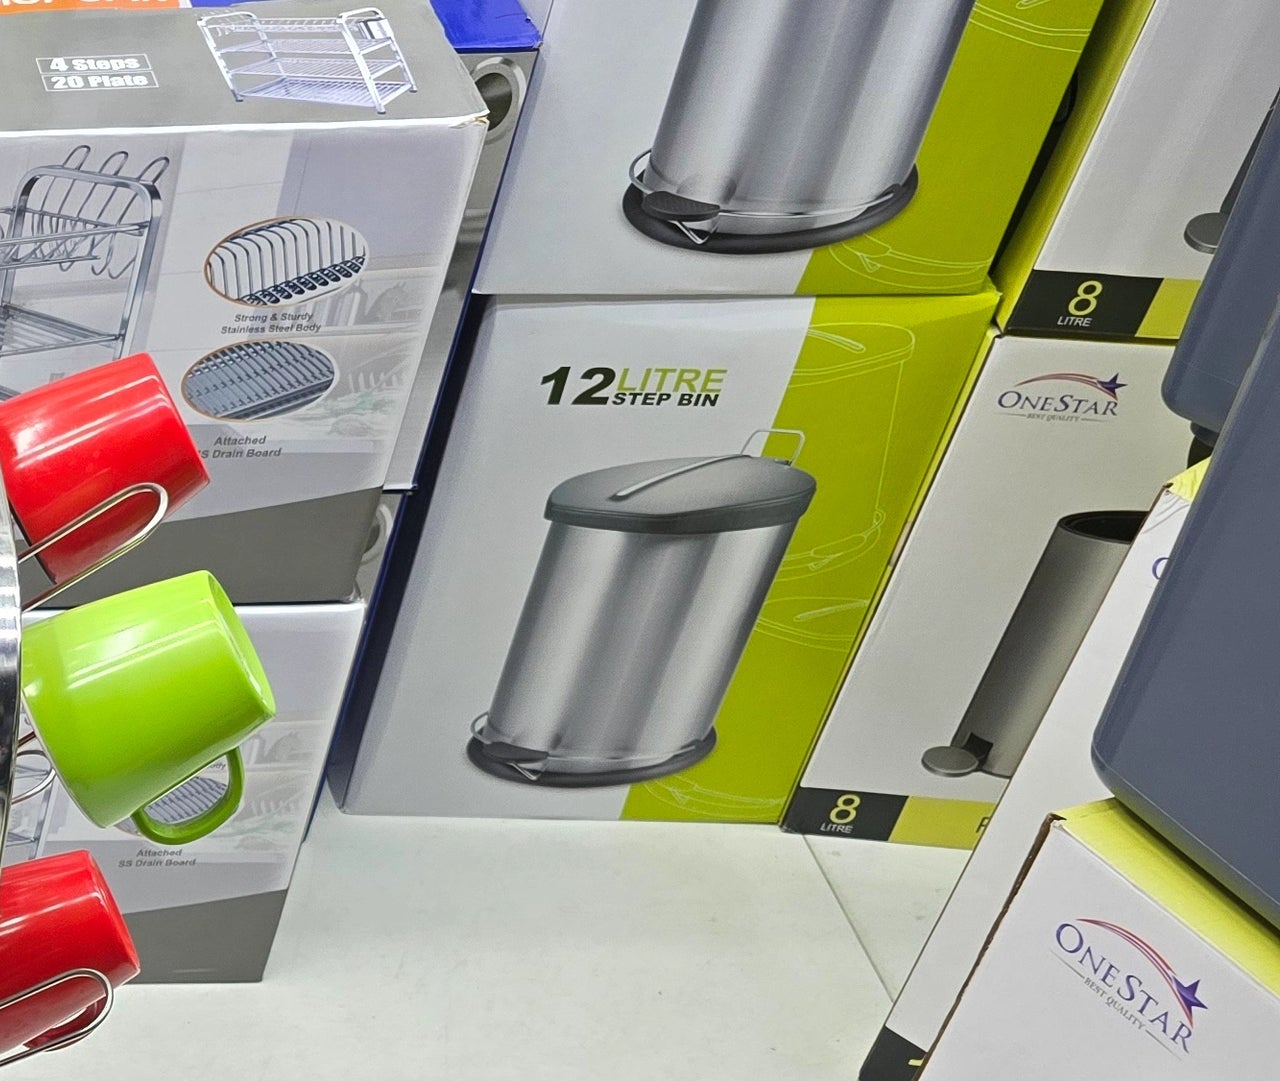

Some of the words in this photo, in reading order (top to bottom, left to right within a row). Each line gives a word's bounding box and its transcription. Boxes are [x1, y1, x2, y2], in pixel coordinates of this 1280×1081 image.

[49, 57, 69, 71] 4
[72, 57, 140, 71] Steps
[50, 75, 84, 89] 20
[87, 74, 148, 87] Plate
[1068, 280, 1103, 316] 8
[234, 313, 267, 323] Strong
[270, 313, 278, 321] &
[280, 312, 313, 323] Sturdy
[1057, 316, 1092, 327] LITRE
[220, 326, 266, 334] Stainless
[268, 325, 293, 333] Steel
[295, 324, 322, 333] Body
[540, 366, 616, 405] 12
[617, 368, 728, 393] LITRE
[612, 393, 671, 406] STEP
[677, 393, 720, 407] BIN
[214, 435, 266, 446] Attached
[212, 449, 243, 458] Drain
[246, 447, 282, 457] Board
[829, 793, 861, 824] 8
[820, 823, 854, 834] LITRE
[136, 849, 183, 857] Attached
[135, 859, 161, 867] Drain
[1084, 976, 1108, 998] BEST
[1104, 995, 1147, 1030] QUALITY
